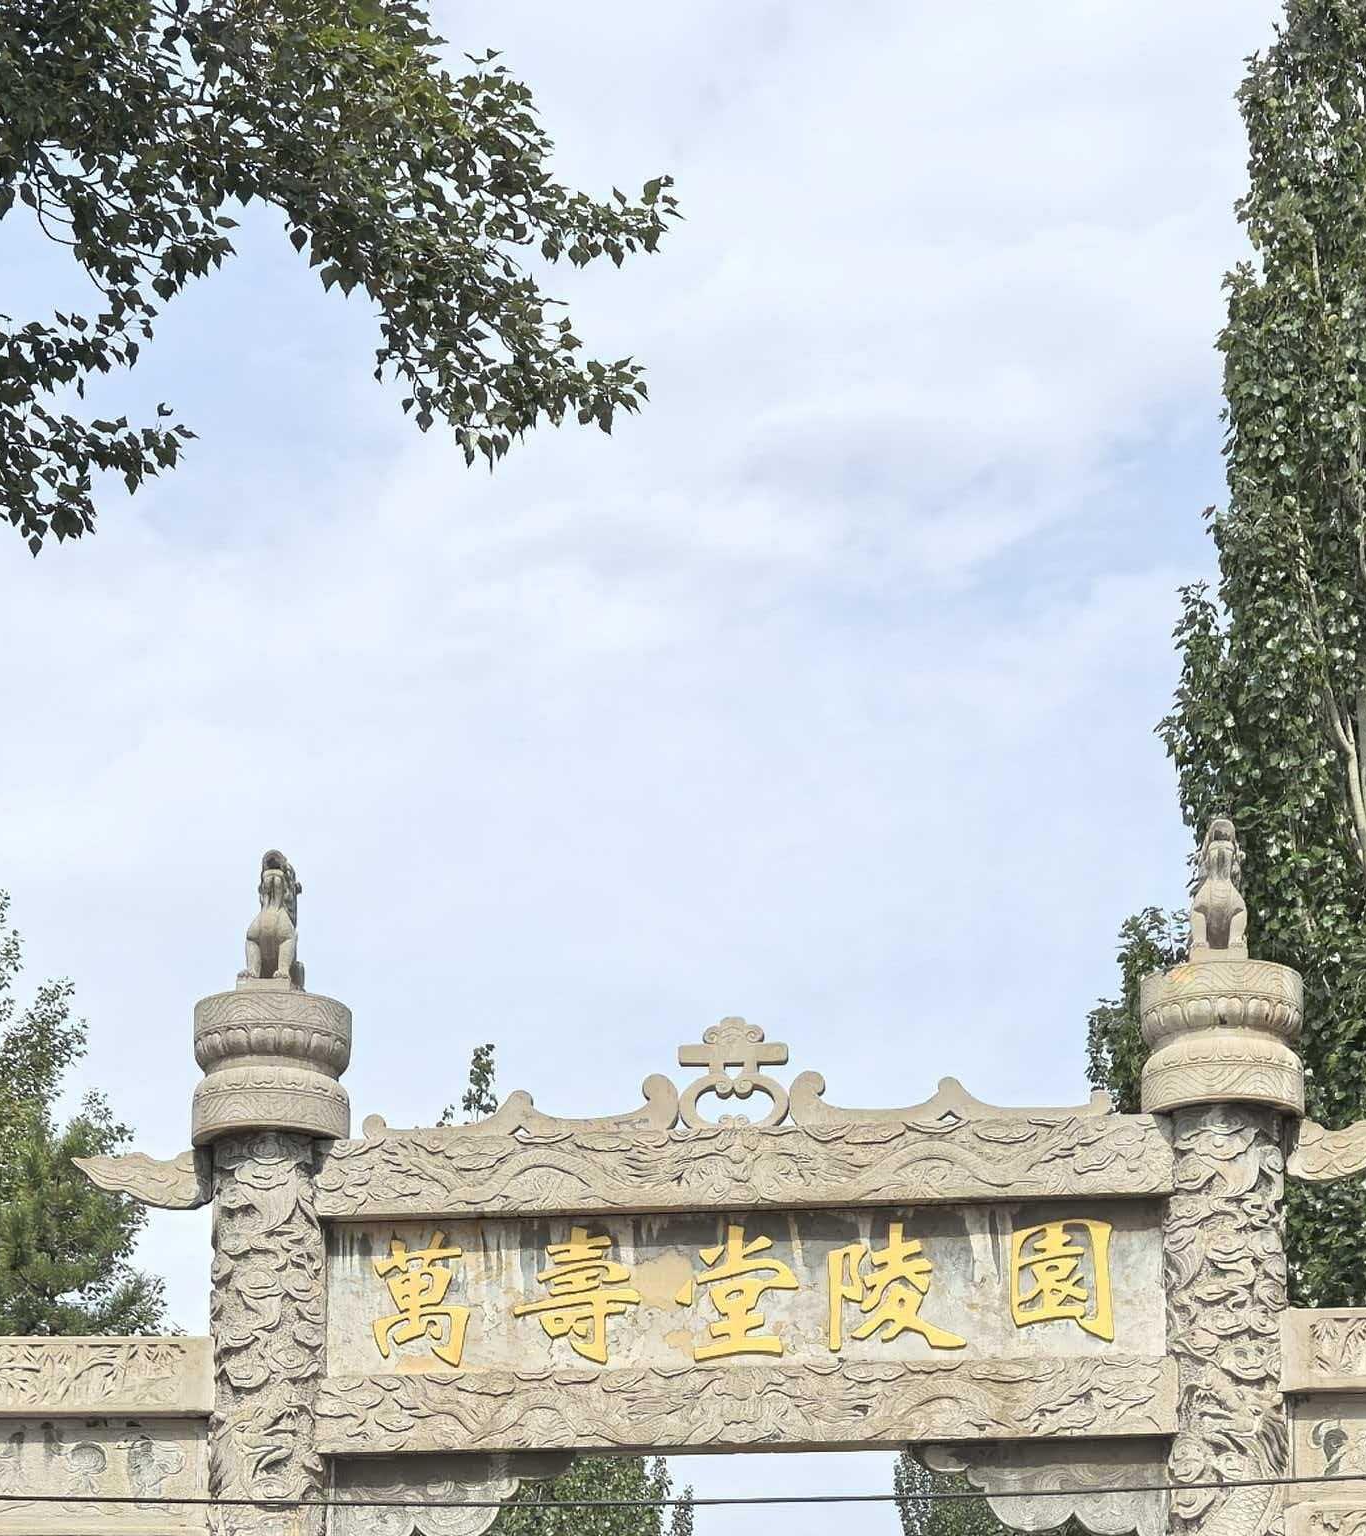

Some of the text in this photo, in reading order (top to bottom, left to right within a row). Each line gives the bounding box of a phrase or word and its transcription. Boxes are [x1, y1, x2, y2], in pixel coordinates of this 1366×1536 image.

[371, 1218, 1114, 1367] 萬壽堂陵園
